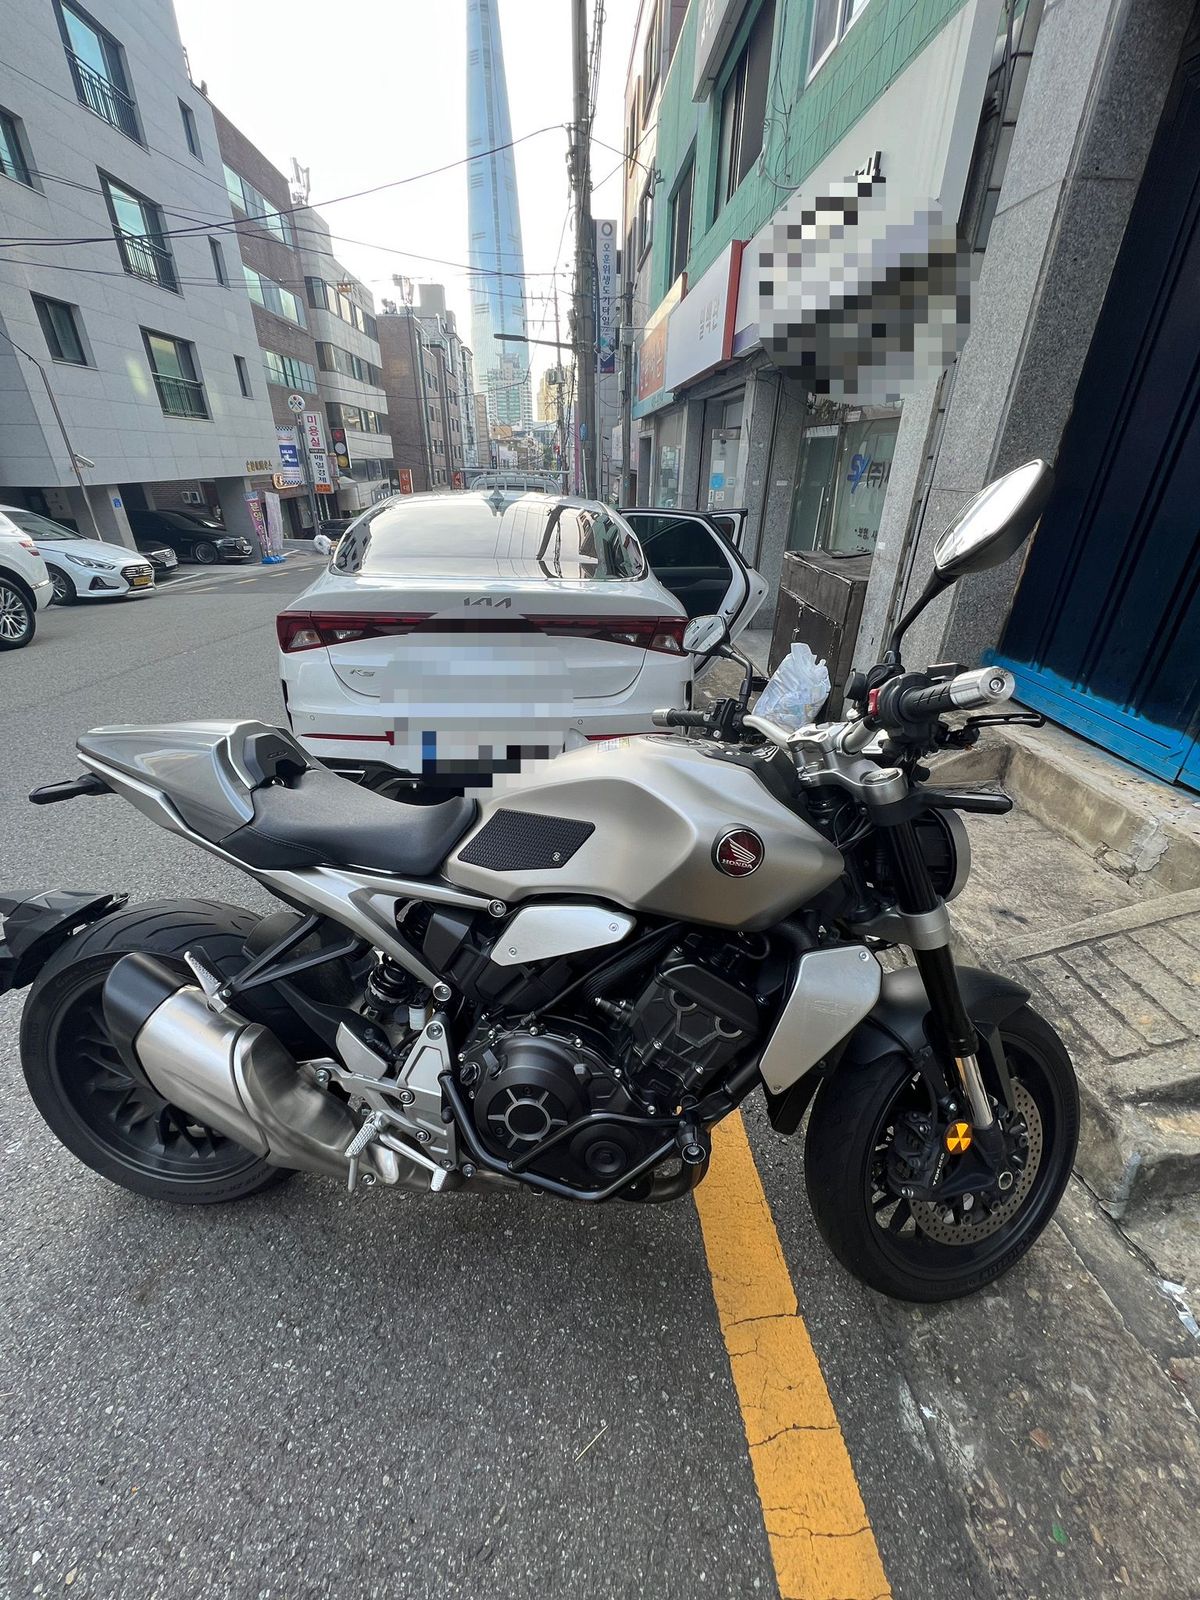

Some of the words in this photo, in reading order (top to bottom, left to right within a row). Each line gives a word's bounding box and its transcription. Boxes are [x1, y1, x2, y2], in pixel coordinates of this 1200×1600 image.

[307, 415, 321, 448] 미용실
[464, 597, 511, 608] KIA
[722, 859, 753, 869] HONDA
